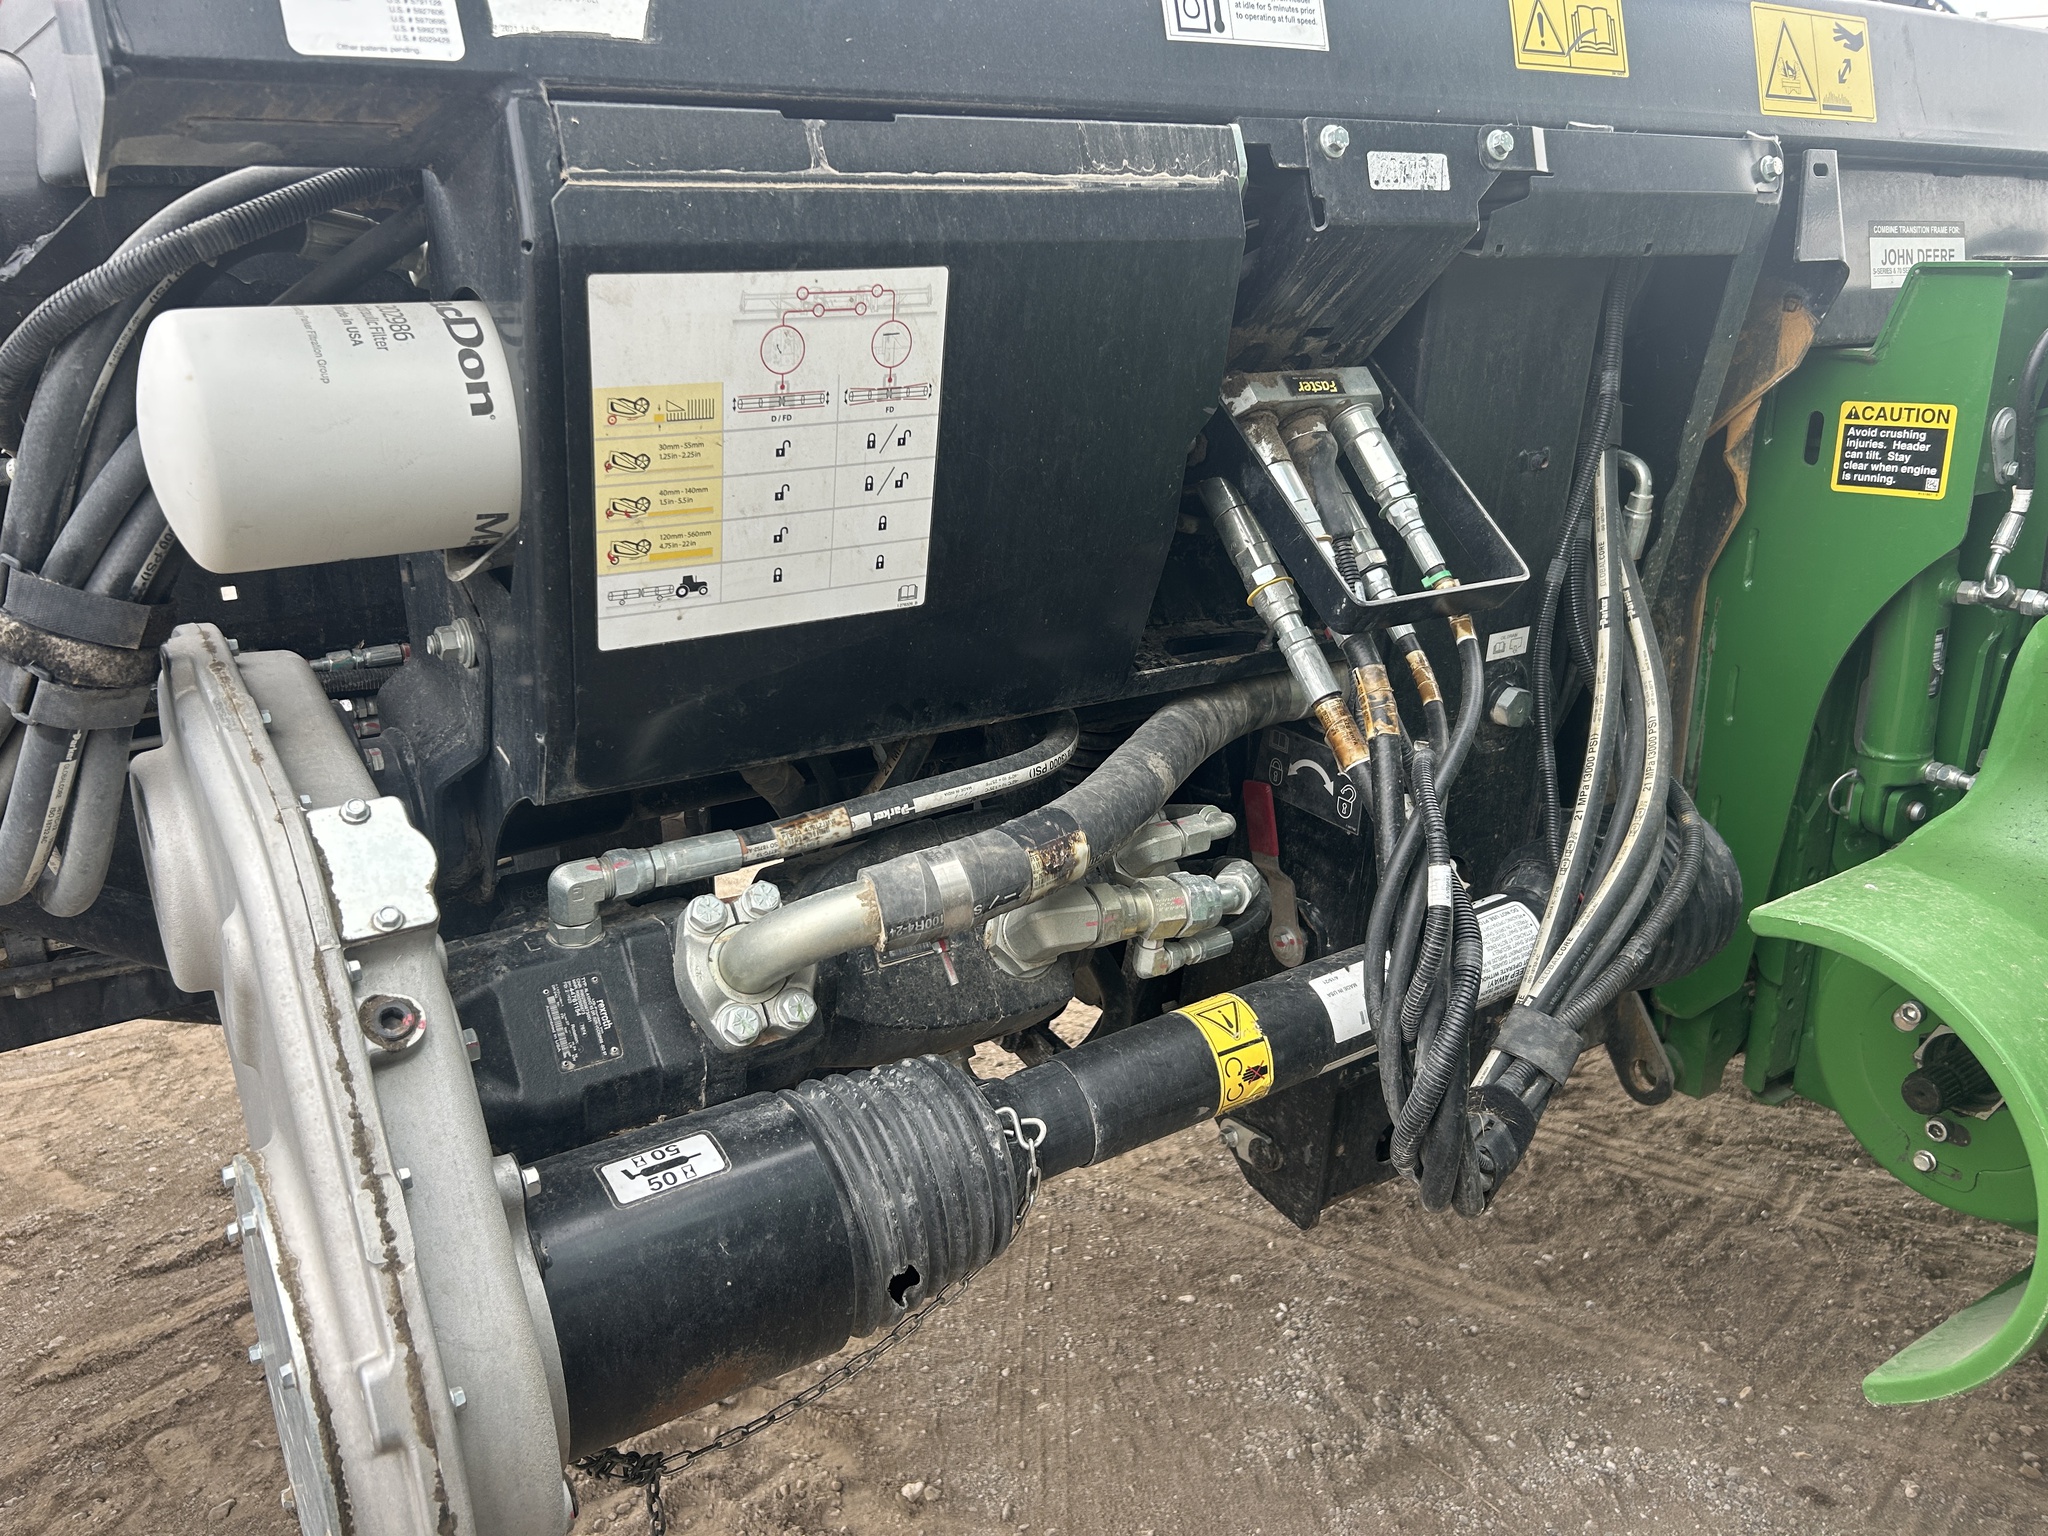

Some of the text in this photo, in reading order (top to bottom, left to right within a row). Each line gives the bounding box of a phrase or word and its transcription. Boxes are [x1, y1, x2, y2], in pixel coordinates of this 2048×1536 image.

[1273, 5, 1299, 13] minutes
[1300, 7, 1315, 15] prior
[1244, 13, 1276, 24] operating
[1285, 15, 1296, 23] full
[1296, 17, 1318, 26] speed.
[360, 45, 388, 53] patents
[1873, 225, 1961, 234] COMBINE TRANSITION FRAME FOR:
[1881, 248, 1914, 266] JOHN
[342, 318, 364, 347] in USA
[369, 326, 389, 352] Filter
[316, 358, 331, 384] Group
[1298, 379, 1338, 394] Faster
[885, 405, 895, 414] FD
[1861, 405, 1951, 425] CAUTION
[771, 414, 777, 423] D
[783, 413, 793, 422] FD
[1847, 426, 1927, 442] Avoid crushing
[684, 442, 705, 450] 55mm
[1846, 438, 1931, 452] injuries. Header
[1844, 450, 1912, 463] can tilt. Stay
[1843, 461, 1938, 477] clear when engine
[1841, 471, 1897, 486] is running.
[659, 488, 681, 496] 40mm
[660, 532, 684, 541] 120mm
[687, 530, 712, 538] 560mm
[141, 552, 163, 581] PSI)
[1647, 715, 1658, 735] PSI)
[65, 729, 82, 761] Parker
[1588, 733, 1600, 754] PSI)
[1647, 736, 1657, 760] (3000
[1028, 767, 1047, 779] PSI)
[1583, 755, 1596, 783] (3000
[1645, 761, 1656, 779] MPa
[1642, 782, 1652, 792] 21
[1577, 784, 1590, 806] MPa
[873, 803, 909, 822] Parker
[1574, 810, 1583, 821] 21
[1499, 961, 1523, 975] OPERATE
[1538, 936, 1574, 985] GLOBALCORE
[1509, 967, 1524, 979] EEP
[1326, 990, 1339, 998] USA
[1343, 982, 1358, 991] MADE
[596, 999, 613, 1030] rexroth
[650, 1144, 681, 1161] 50
[647, 1171, 678, 1192] 50
